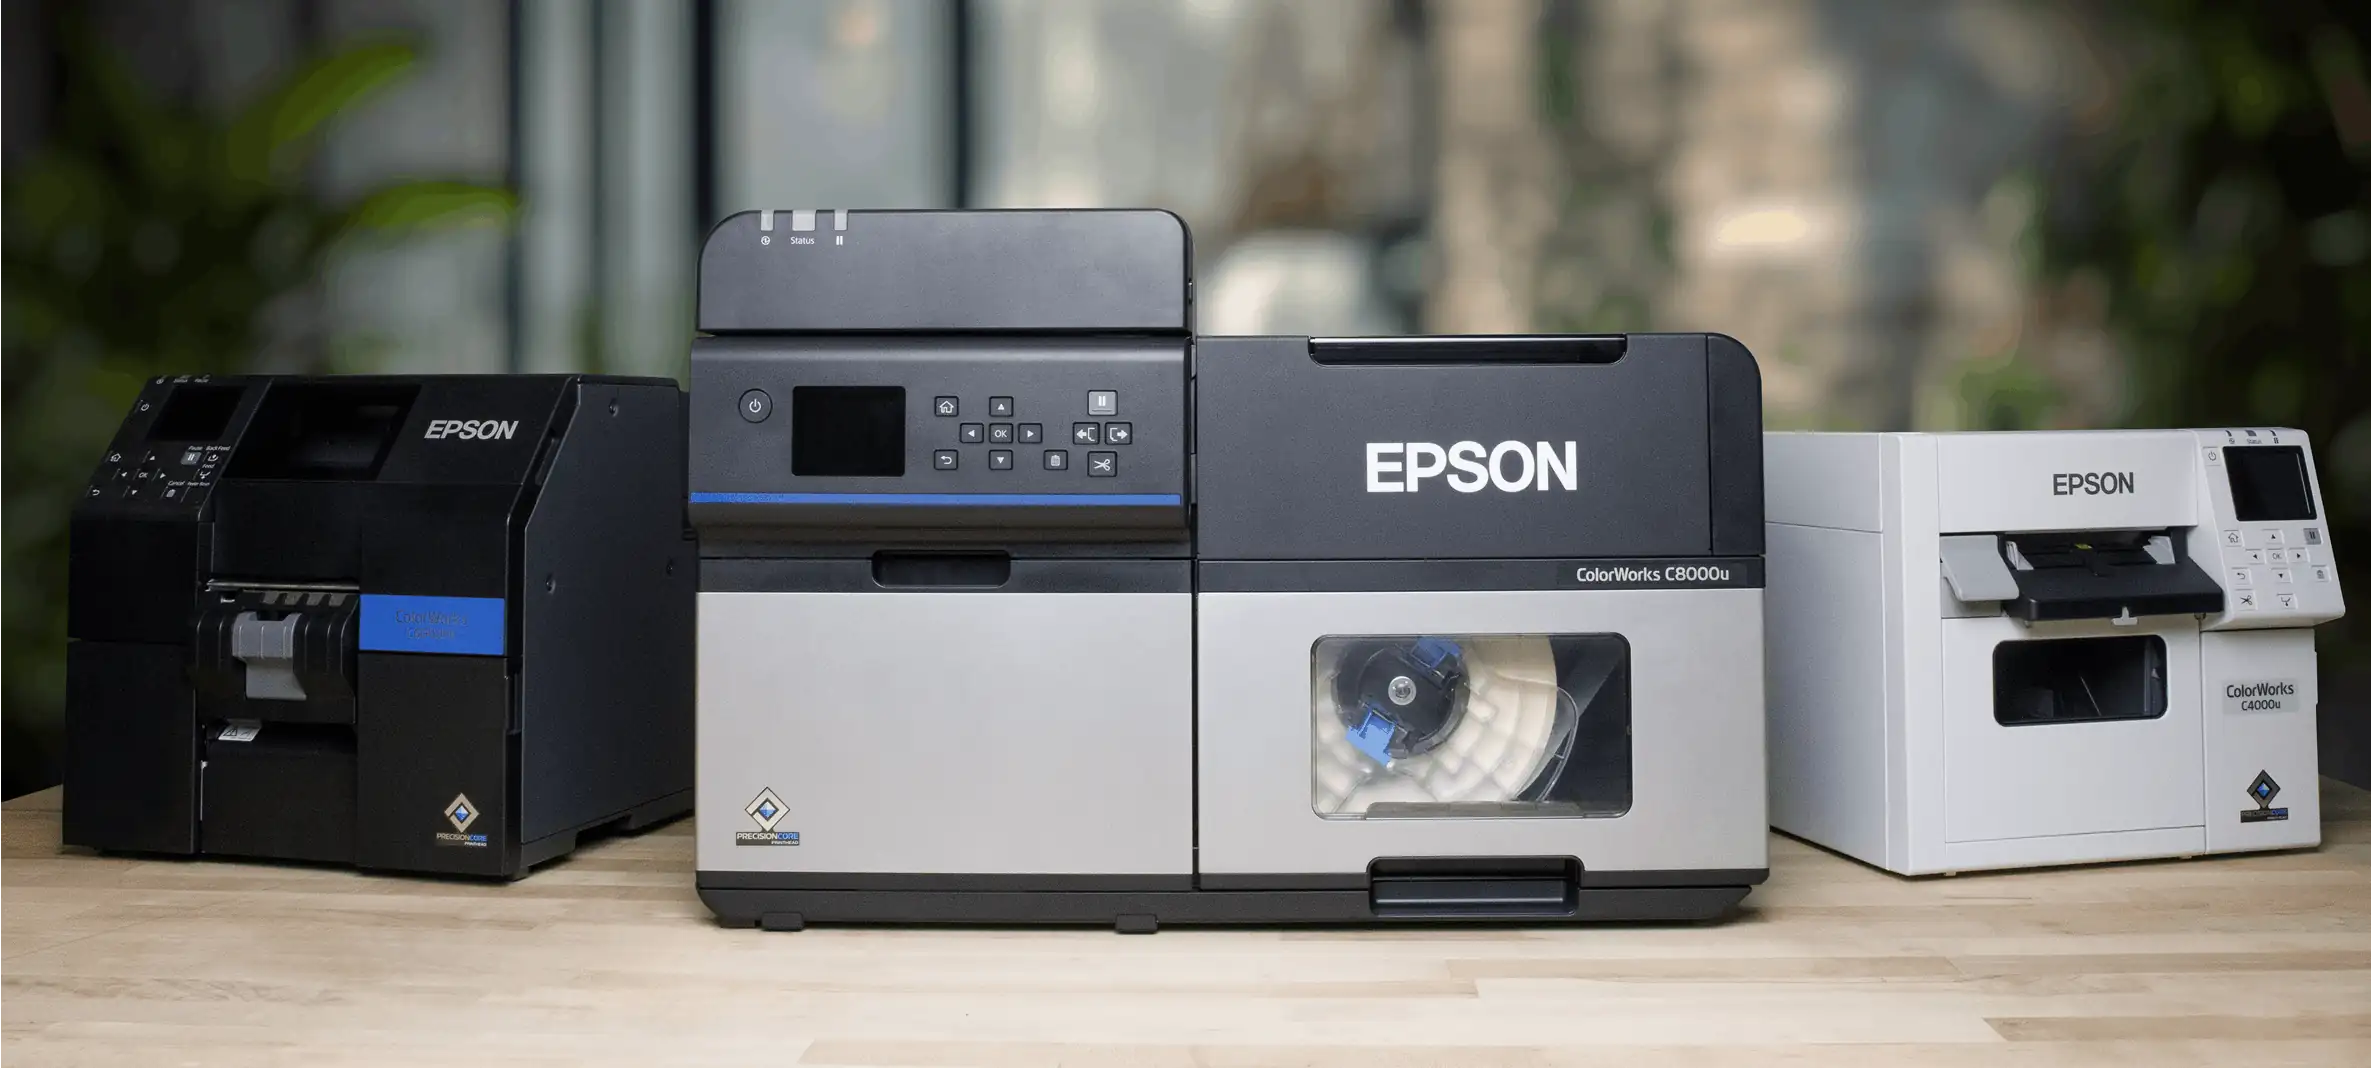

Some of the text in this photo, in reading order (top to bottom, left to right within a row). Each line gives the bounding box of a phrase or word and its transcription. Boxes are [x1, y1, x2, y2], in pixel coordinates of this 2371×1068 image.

[790, 236, 815, 245] Status
[424, 419, 519, 440] EPSON
[994, 429, 1007, 438] OK
[1366, 440, 1578, 493] EPSON
[2053, 472, 2135, 495] EPSON
[2272, 552, 2282, 560] OK
[1576, 566, 1730, 582] ColorWorks C8000u
[2226, 682, 2294, 698] ColorWorks
[2241, 698, 2281, 711] C4000u
